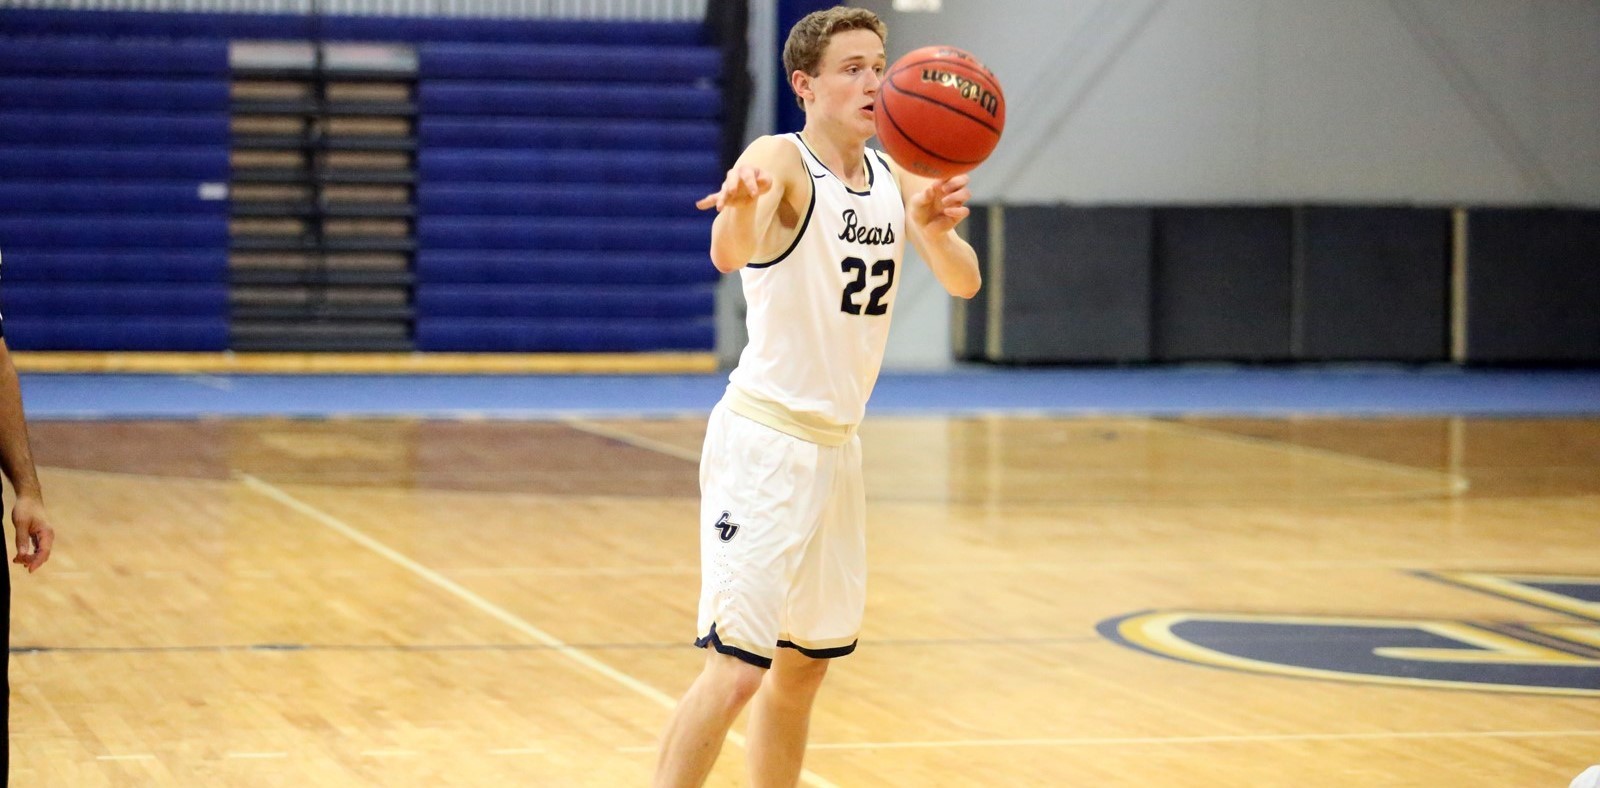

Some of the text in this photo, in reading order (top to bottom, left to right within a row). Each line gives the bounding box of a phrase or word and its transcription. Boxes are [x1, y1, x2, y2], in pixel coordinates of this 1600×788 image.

[922, 69, 998, 118] Wilson
[838, 209, 895, 245] Bears
[841, 257, 895, 315] 22
